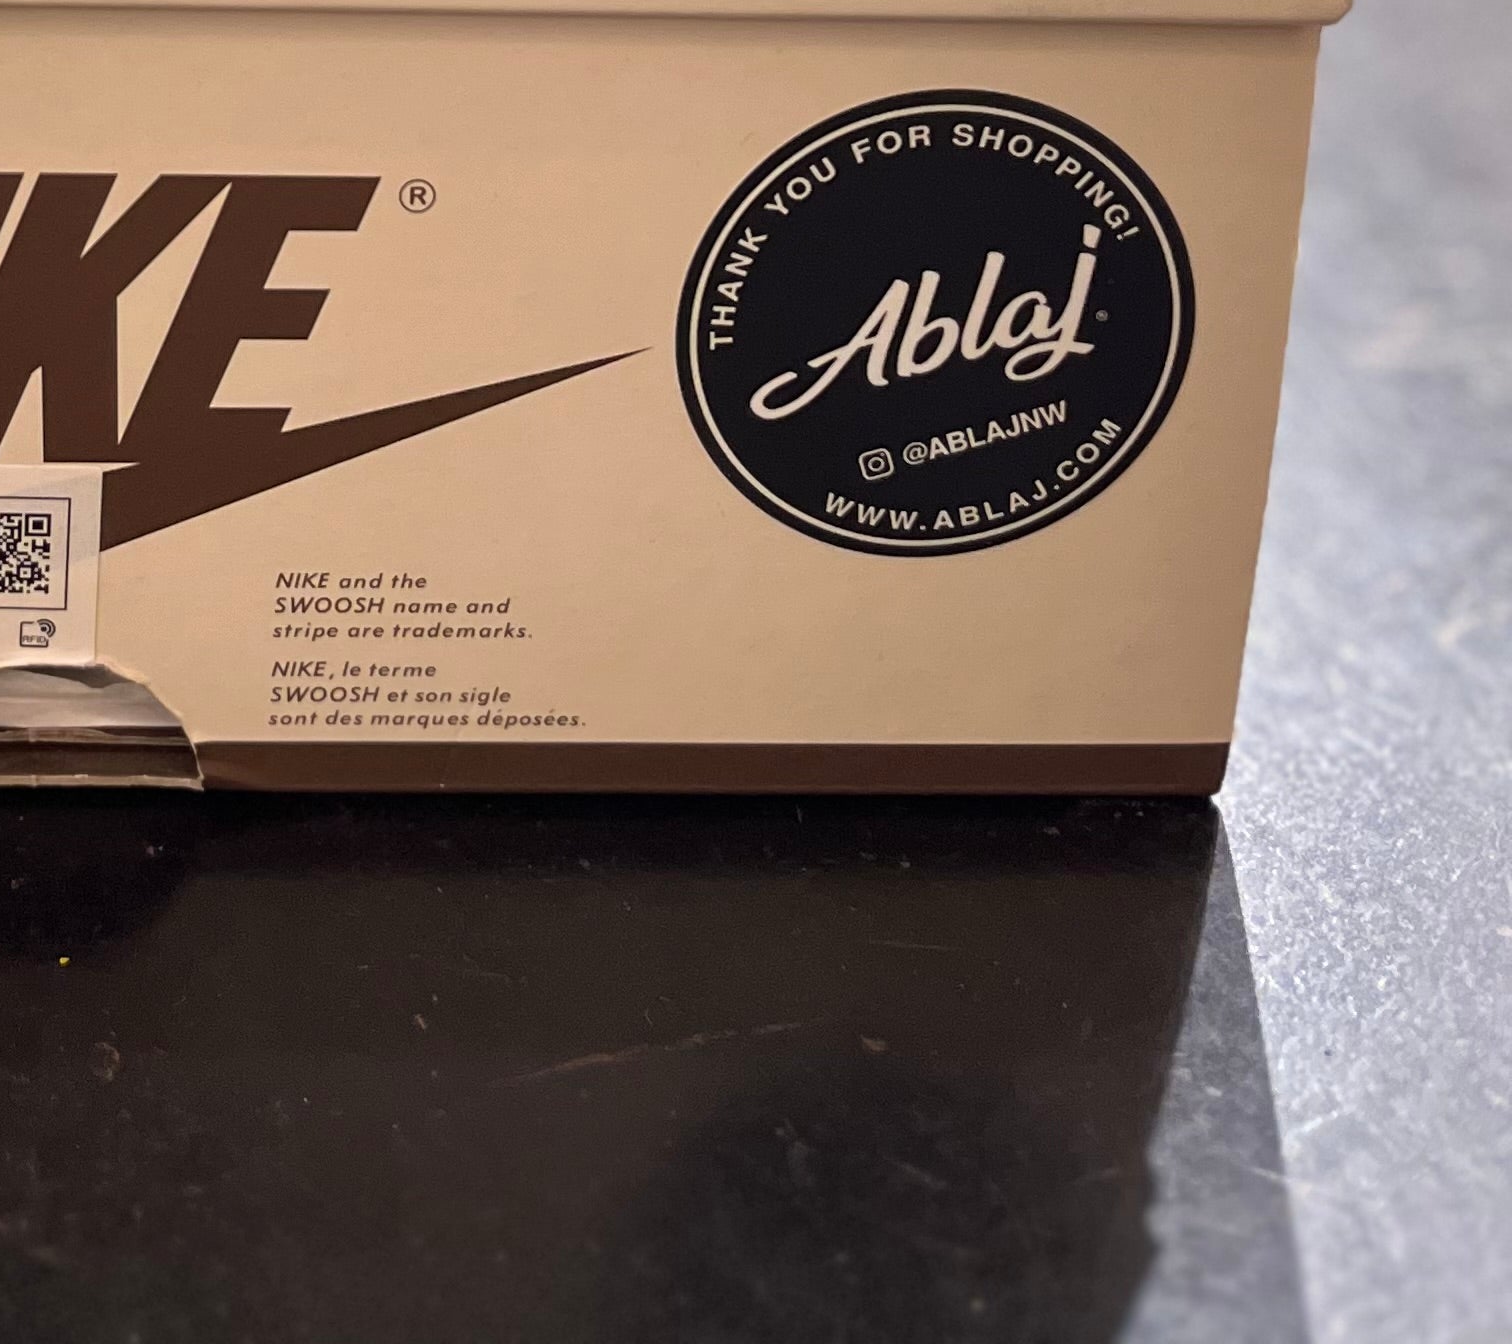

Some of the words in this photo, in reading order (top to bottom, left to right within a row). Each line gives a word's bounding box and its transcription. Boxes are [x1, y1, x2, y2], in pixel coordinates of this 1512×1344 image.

[709, 226, 768, 351] THANK
[764, 156, 837, 216] YOU
[850, 124, 932, 164] FOR
[951, 123, 1140, 242] SHOPPING!
[749, 223, 1102, 421] Ablaj
[902, 400, 1069, 466] @ABLAJNW
[824, 418, 1122, 531] WWW.ABLAJ.COM
[275, 572, 331, 589] NIKE
[338, 572, 384, 590] and
[391, 572, 427, 589] the
[274, 596, 386, 614] SWOOSH
[392, 602, 458, 614] name
[466, 597, 511, 615] and
[272, 621, 339, 642] stripe
[347, 626, 385, 638] are
[392, 621, 533, 639] trademarks.
[271, 660, 335, 681] NIKE,
[341, 660, 362, 678] le
[369, 663, 437, 678] terme
[270, 686, 380, 703] SWOOSH
[387, 689, 409, 703] et
[414, 691, 452, 703] son
[458, 686, 512, 707] sigle
[268, 711, 318, 726] sont
[324, 709, 363, 726] des
[370, 714, 470, 730] marques
[476, 708, 586, 730] déposées.
